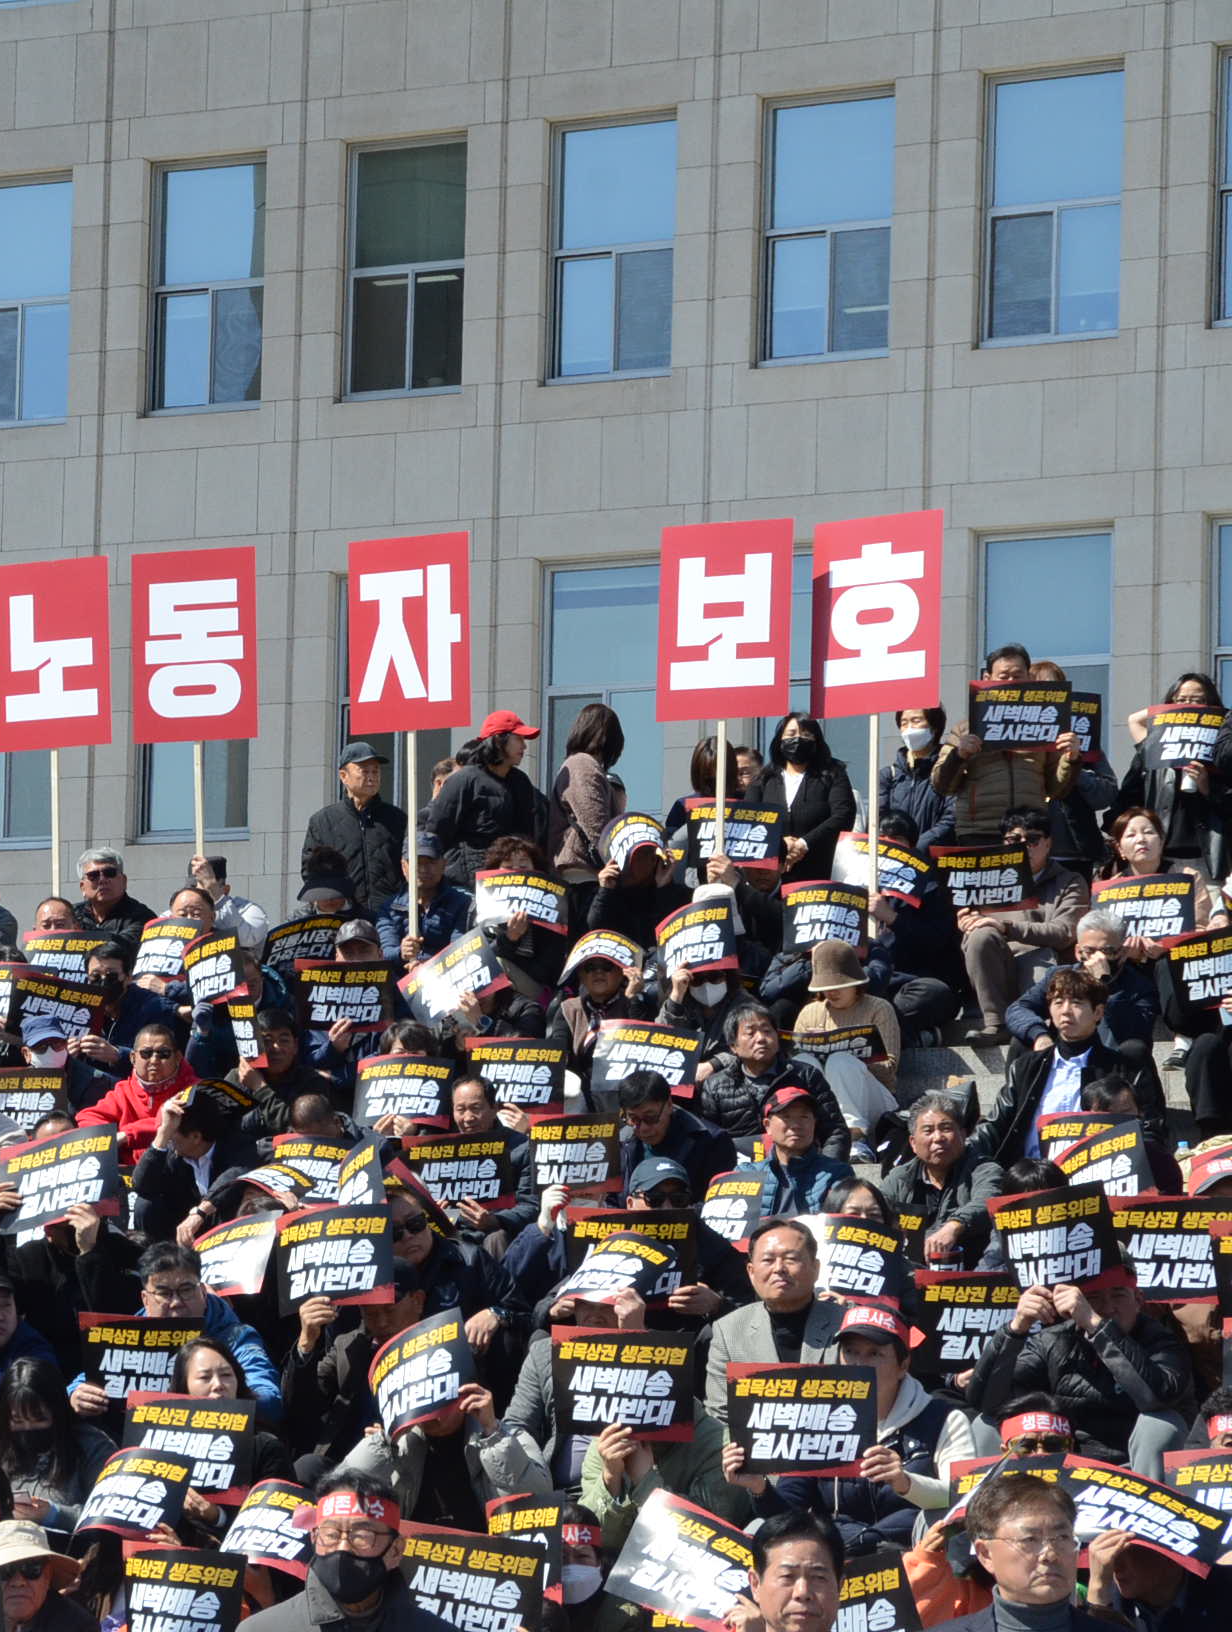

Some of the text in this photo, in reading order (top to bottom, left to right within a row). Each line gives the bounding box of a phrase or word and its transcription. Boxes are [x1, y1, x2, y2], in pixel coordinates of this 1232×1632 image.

[670, 552, 774, 691] 보
[824, 542, 925, 687] 호
[358, 563, 461, 703] 자
[5, 595, 98, 722] 노
[145, 578, 244, 718] 동
[976, 689, 1067, 702] 골목상권 생존위협
[982, 705, 1057, 722] 새벽배송
[985, 724, 1060, 742] 결사반대
[937, 852, 1024, 868] 골목상권 생존위협
[947, 868, 1018, 888] 새벽배송
[786, 891, 867, 908] 골목상권 생존위협
[951, 887, 1022, 906] 결사반대
[1097, 883, 1189, 901] 골목상권 생존위협
[300, 969, 388, 983] 골목상권 생존위협
[308, 986, 379, 1004] 새벽배송
[310, 1005, 381, 1022] 결사반대
[471, 1048, 562, 1062] 골목상권 생존위협
[359, 1064, 450, 1079] 골목상권 생존위협
[480, 1064, 552, 1083] 새벽배송
[364, 1079, 439, 1097] 새벽배송
[366, 1093, 438, 1115] 결사반대
[531, 1123, 614, 1139] 골목상권 생존위협
[7, 1136, 111, 1172] 골목상권 생존위협
[409, 1141, 504, 1159] 골목상권 생존위협
[535, 1142, 604, 1163] 새벽배송
[19, 1156, 101, 1192] 새벽배송
[421, 1159, 497, 1179] 새벽배송
[537, 1162, 608, 1184] 결사반대
[21, 1179, 103, 1217] 결사반대
[426, 1179, 501, 1199] 결사반대
[994, 1196, 1101, 1229] 골목상권 생존위협
[1113, 1211, 1178, 1228] 골목상권
[280, 1217, 387, 1246] 골목상권 생존위협
[1008, 1221, 1094, 1258] 새벽배송
[289, 1239, 374, 1271] 새벽배송
[1015, 1249, 1101, 1286] 결사반대
[290, 1265, 377, 1299] 결사반대
[925, 1285, 987, 1302] 골목상권
[846, 1307, 897, 1329] 생존사수
[88, 1327, 140, 1345] 골목상권
[559, 1341, 688, 1364] 골목상권 생존위협
[569, 1367, 673, 1396] 새벽배송
[736, 1379, 870, 1398] 골목상권 생존위협
[132, 1406, 249, 1431] 골목상권 생존위협
[573, 1395, 676, 1426] 결사반대
[747, 1403, 857, 1431] 새벽배송
[140, 1429, 234, 1460] 새벽배송
[751, 1433, 860, 1461] 결사반대
[321, 1495, 385, 1518] 생존사수
[1069, 1467, 1221, 1530] 골목상권 생존위협
[1074, 1485, 1200, 1540] 새벽배송
[402, 1539, 539, 1576] 골목상권 생존위협
[125, 1559, 238, 1587] 골목상권 생존위협
[409, 1566, 521, 1608] 새벽배송
